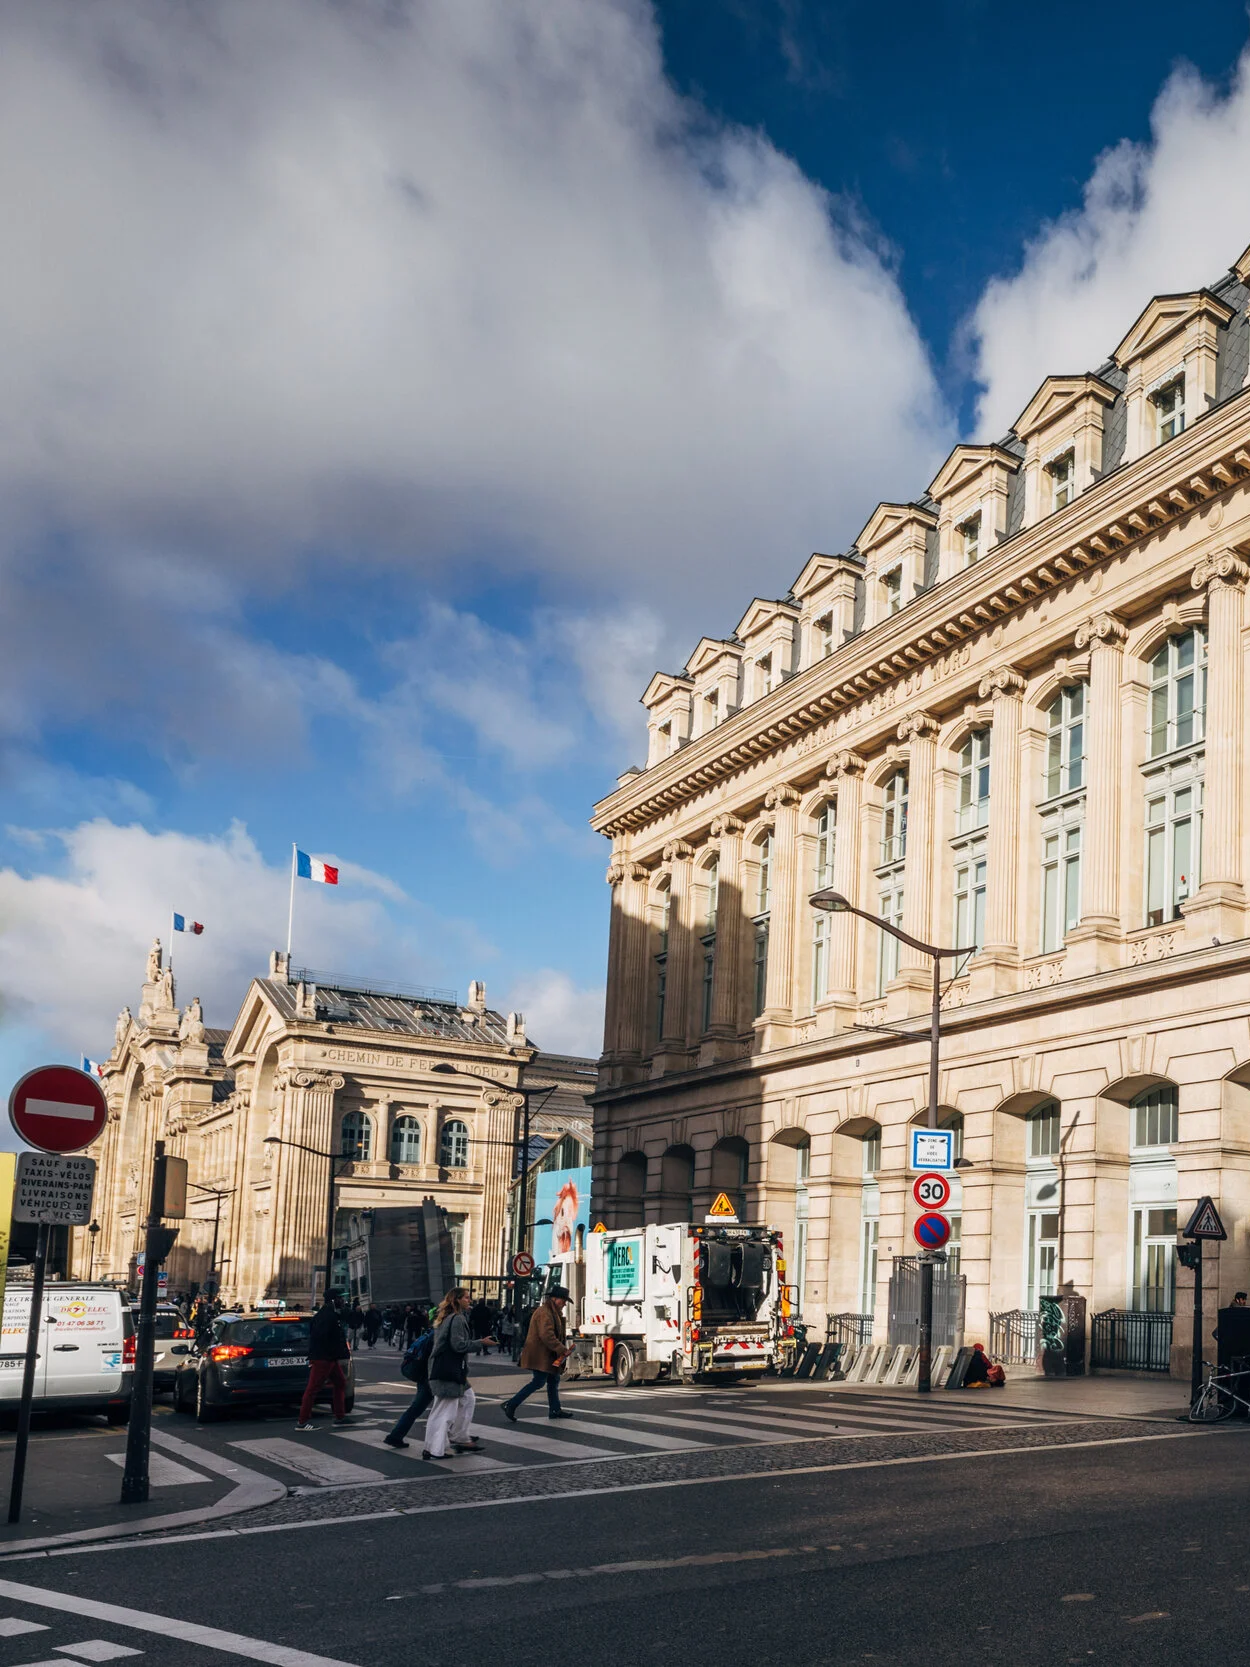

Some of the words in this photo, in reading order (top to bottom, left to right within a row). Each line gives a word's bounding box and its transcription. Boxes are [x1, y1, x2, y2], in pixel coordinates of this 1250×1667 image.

[328, 1049, 380, 1064] CHEMIN
[386, 1055, 404, 1067] DE
[465, 1064, 499, 1078] NORD
[32, 1159, 59, 1168] SAUF
[66, 1161, 87, 1170] BUS
[21, 1178, 92, 1190] RIVERAINS-PAM
[22, 1189, 89, 1200] LIVRAISONS
[920, 1183, 944, 1200] 30
[612, 1246, 633, 1266] MERC
